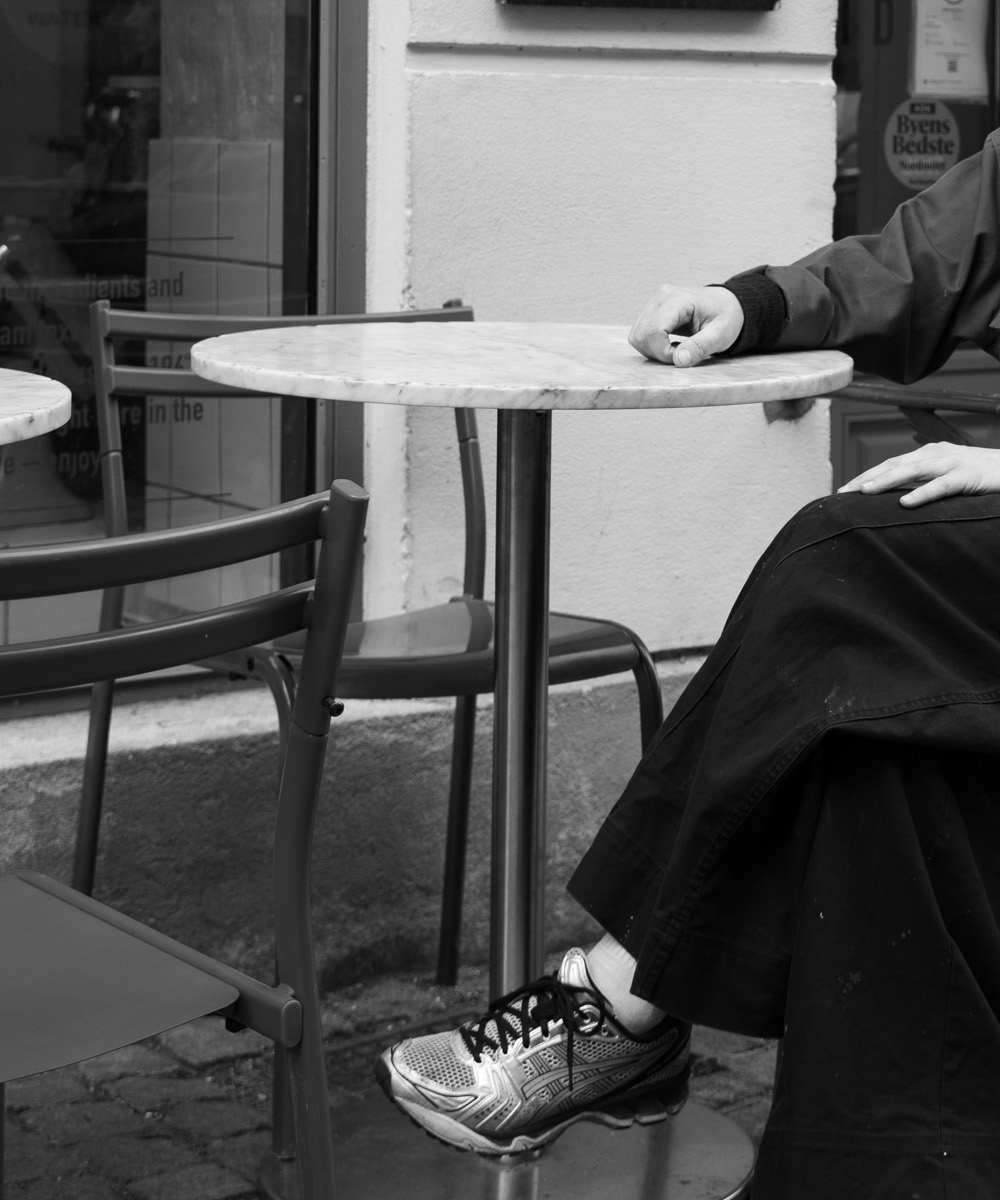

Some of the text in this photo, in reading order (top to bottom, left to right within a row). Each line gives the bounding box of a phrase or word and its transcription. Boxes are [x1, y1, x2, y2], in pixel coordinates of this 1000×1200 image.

[896, 114, 951, 138] Byens
[892, 135, 955, 156] Bedste
[148, 271, 184, 298] and
[149, 399, 166, 424] in
[174, 397, 204, 422] the
